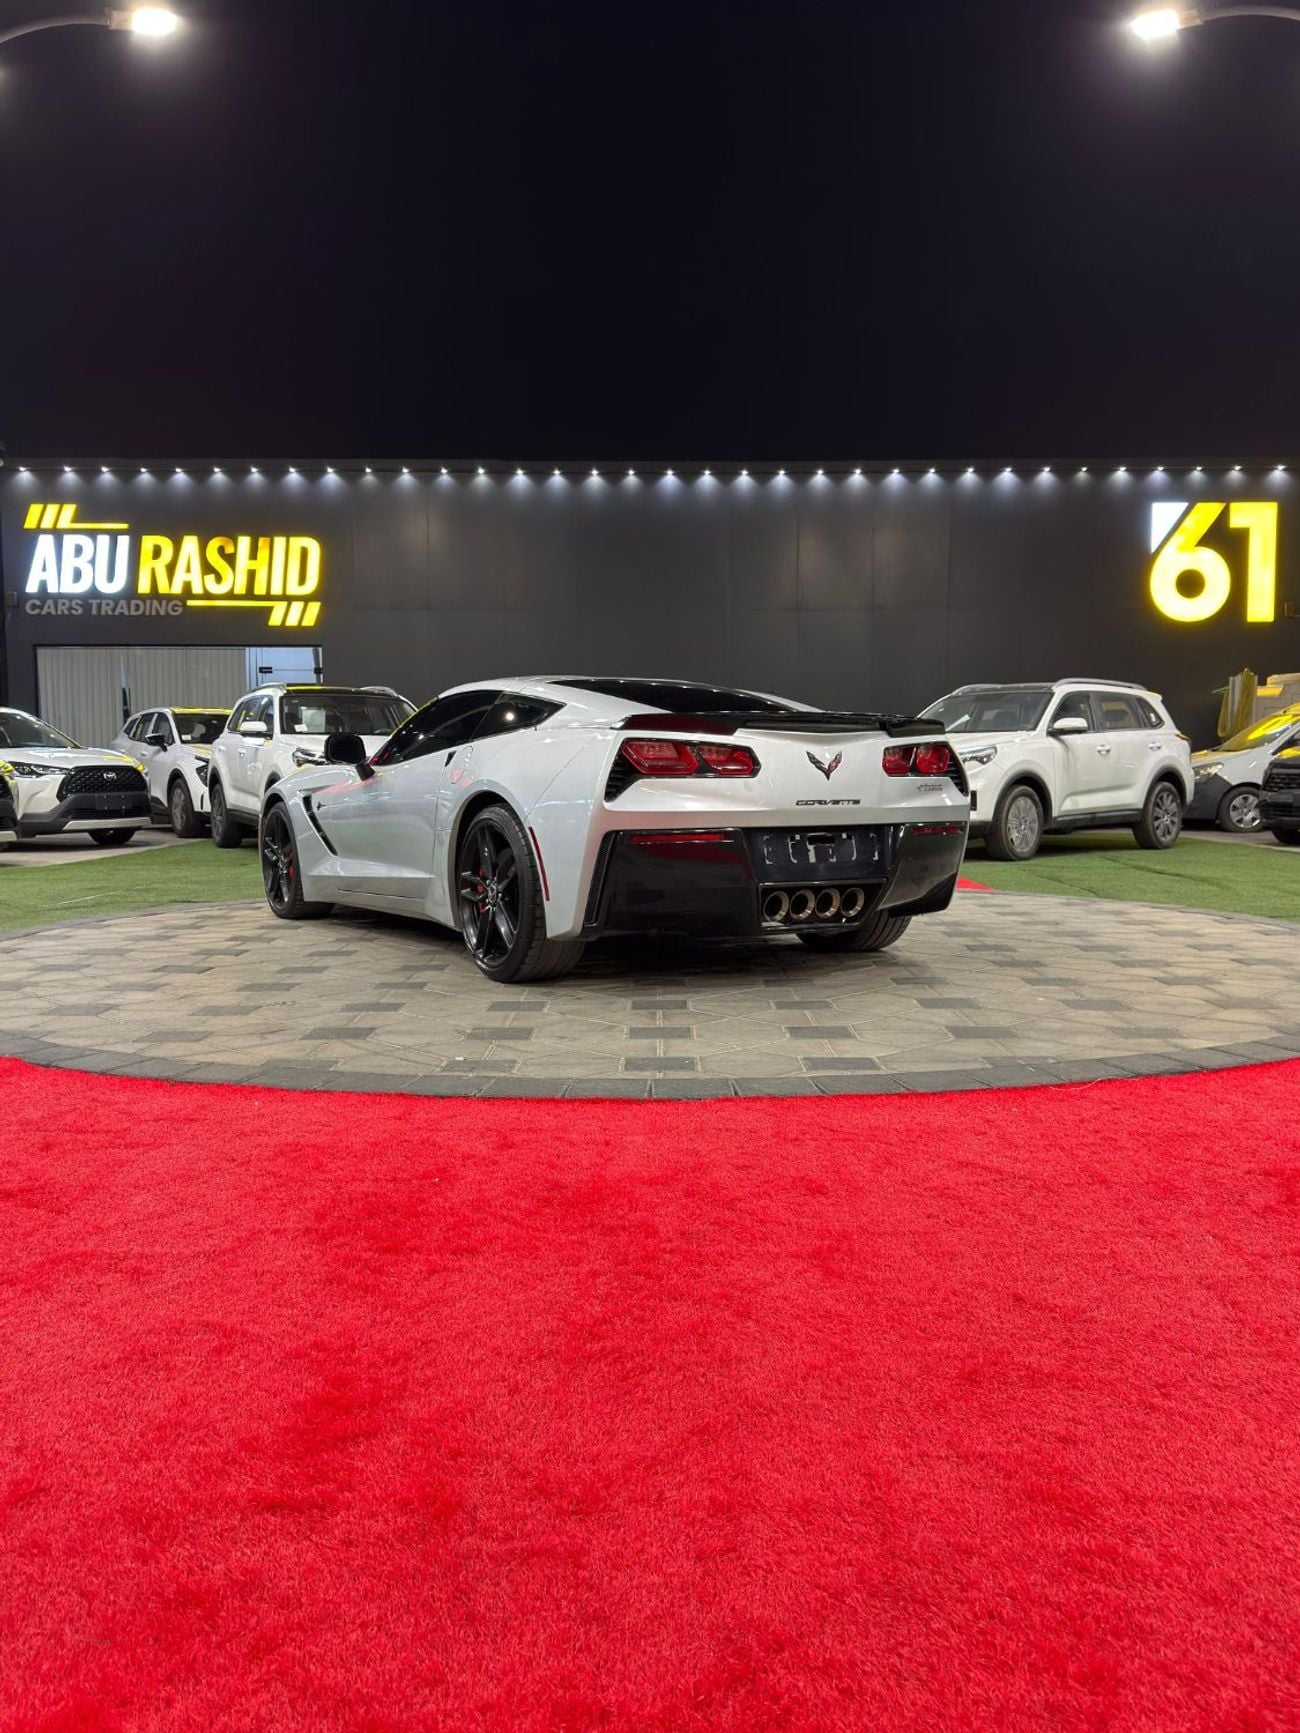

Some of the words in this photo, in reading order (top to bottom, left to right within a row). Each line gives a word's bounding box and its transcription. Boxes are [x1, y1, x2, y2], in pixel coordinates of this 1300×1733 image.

[25, 534, 130, 594] ABU
[137, 535, 321, 596] RASHID
[1150, 502, 1278, 622] 61
[25, 599, 83, 616] CARS
[88, 599, 184, 616] TRADING
